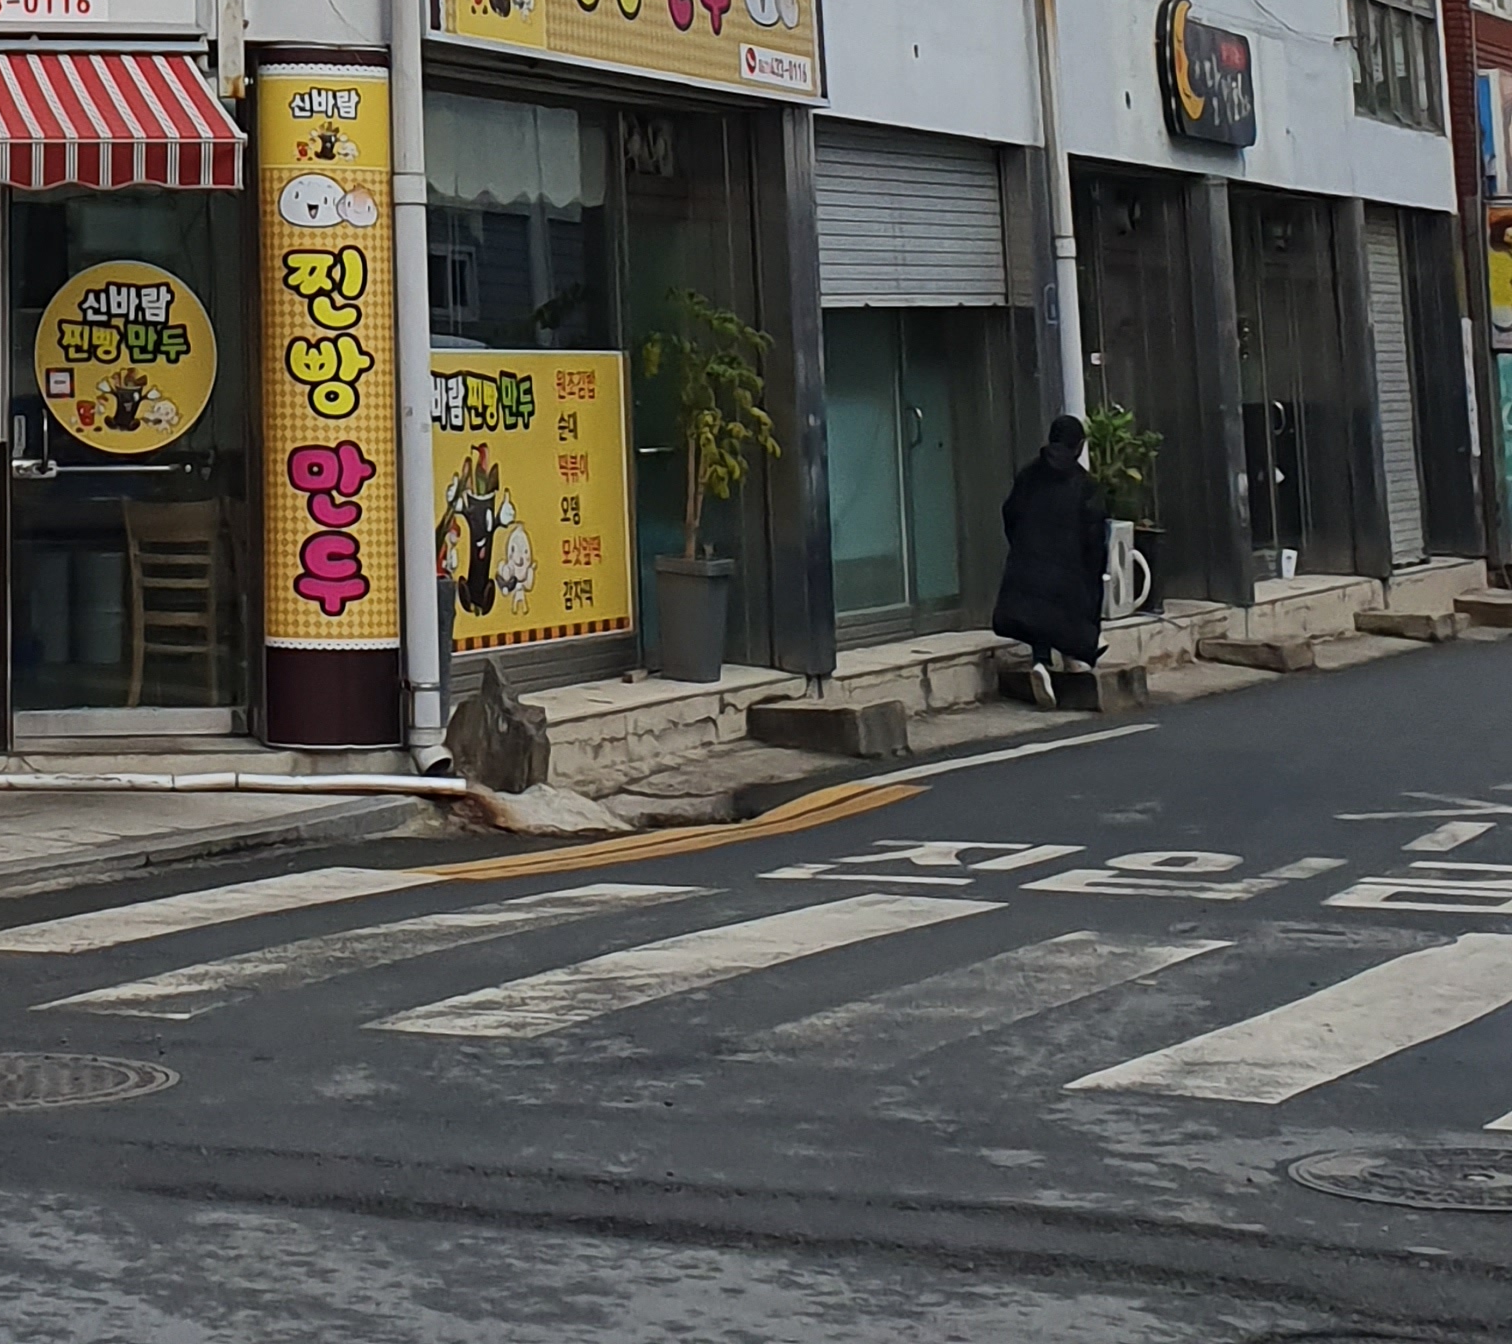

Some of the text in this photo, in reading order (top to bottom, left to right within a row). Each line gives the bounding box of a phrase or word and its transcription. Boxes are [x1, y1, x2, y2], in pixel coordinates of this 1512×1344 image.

[288, 87, 362, 120] 신바람
[77, 281, 175, 324] 신바람
[57, 319, 191, 364] 찐빵 만두
[431, 370, 535, 432] 바람 찐빵 만두
[283, 244, 376, 616] 찐빵 만두
[558, 411, 578, 441] 순대
[560, 495, 580, 525] 오뎅
[563, 579, 593, 610] 감자떡
